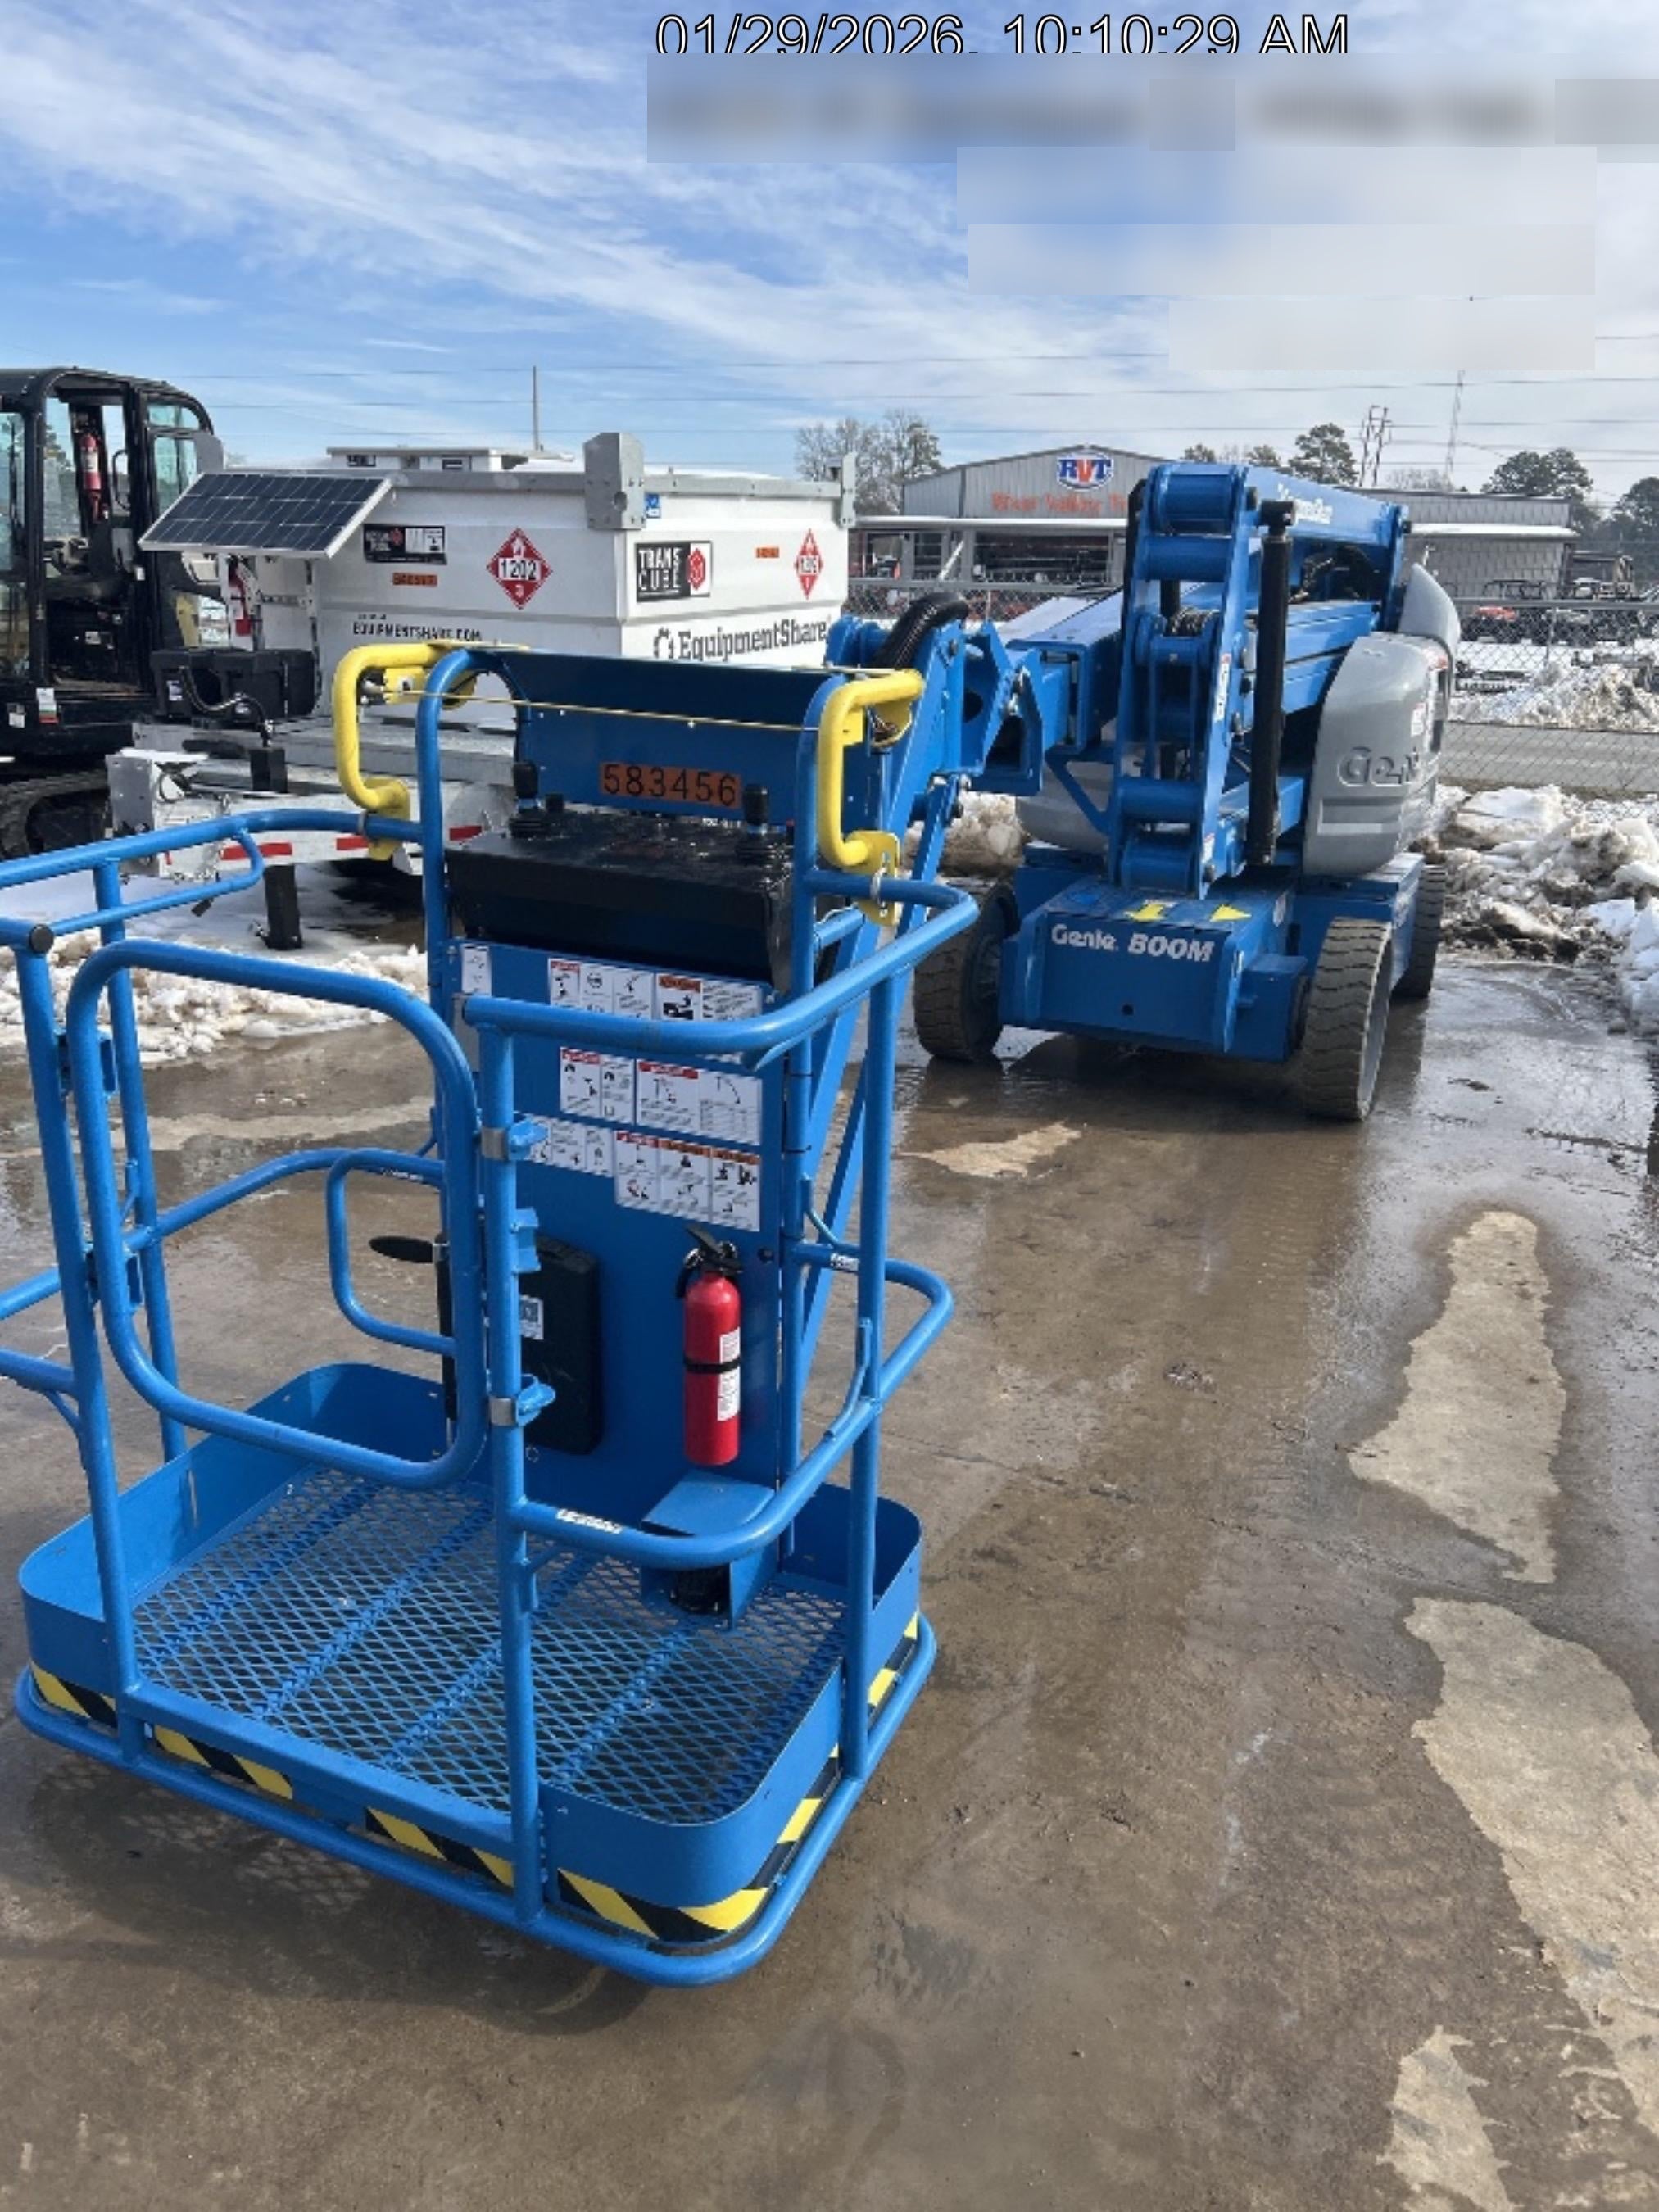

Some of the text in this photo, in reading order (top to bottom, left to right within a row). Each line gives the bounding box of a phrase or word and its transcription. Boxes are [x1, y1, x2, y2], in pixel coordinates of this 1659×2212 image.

[1058, 459, 1112, 483] RVT
[501, 559, 537, 581] 1202
[638, 547, 682, 569] TRANS
[678, 617, 827, 662] EquipmentShare
[603, 764, 737, 806] 583456
[1127, 932, 1215, 963] BOOM
